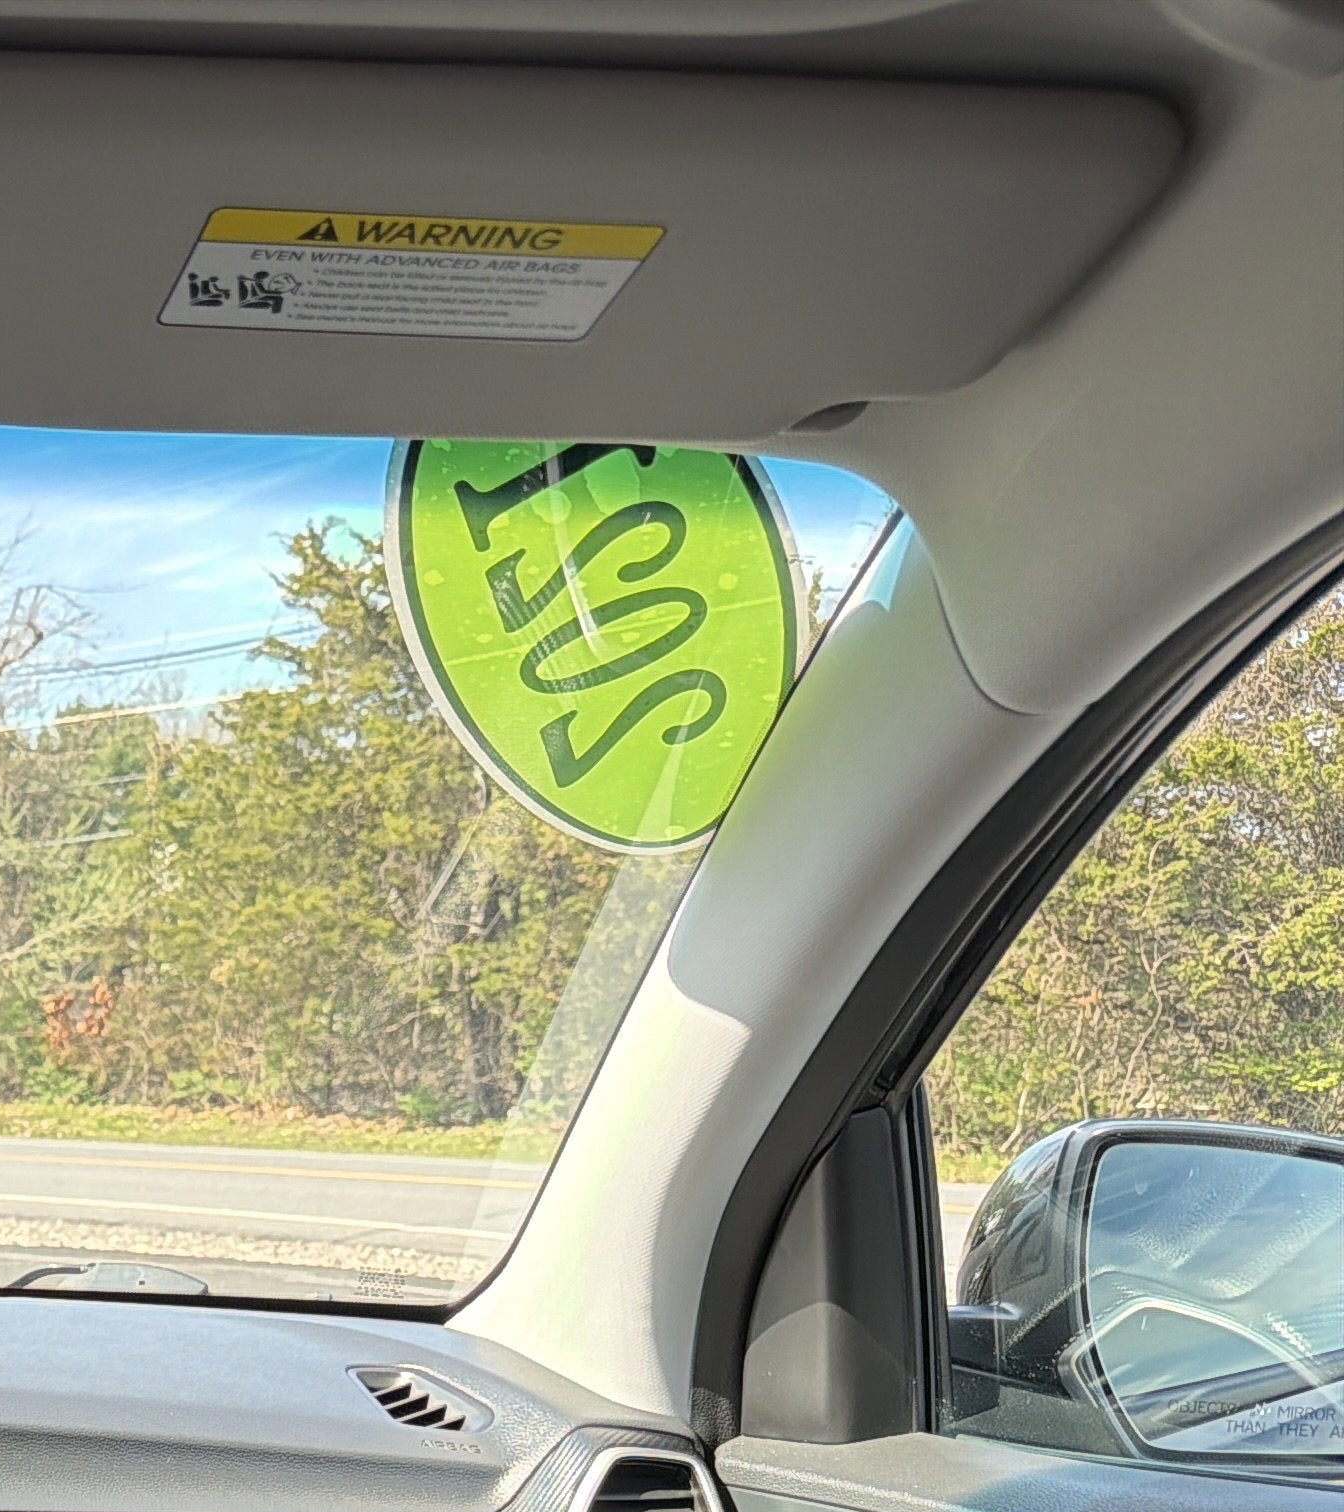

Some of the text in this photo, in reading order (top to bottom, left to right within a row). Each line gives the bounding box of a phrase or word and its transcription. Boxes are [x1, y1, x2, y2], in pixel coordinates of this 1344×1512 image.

[355, 219, 567, 250] WARNING
[250, 249, 581, 273] EVEN WITH ADVANCED AIR BAGS
[1276, 1405, 1336, 1422] MIRROR
[1225, 1419, 1266, 1434] THAN
[1277, 1422, 1320, 1437] THEY
